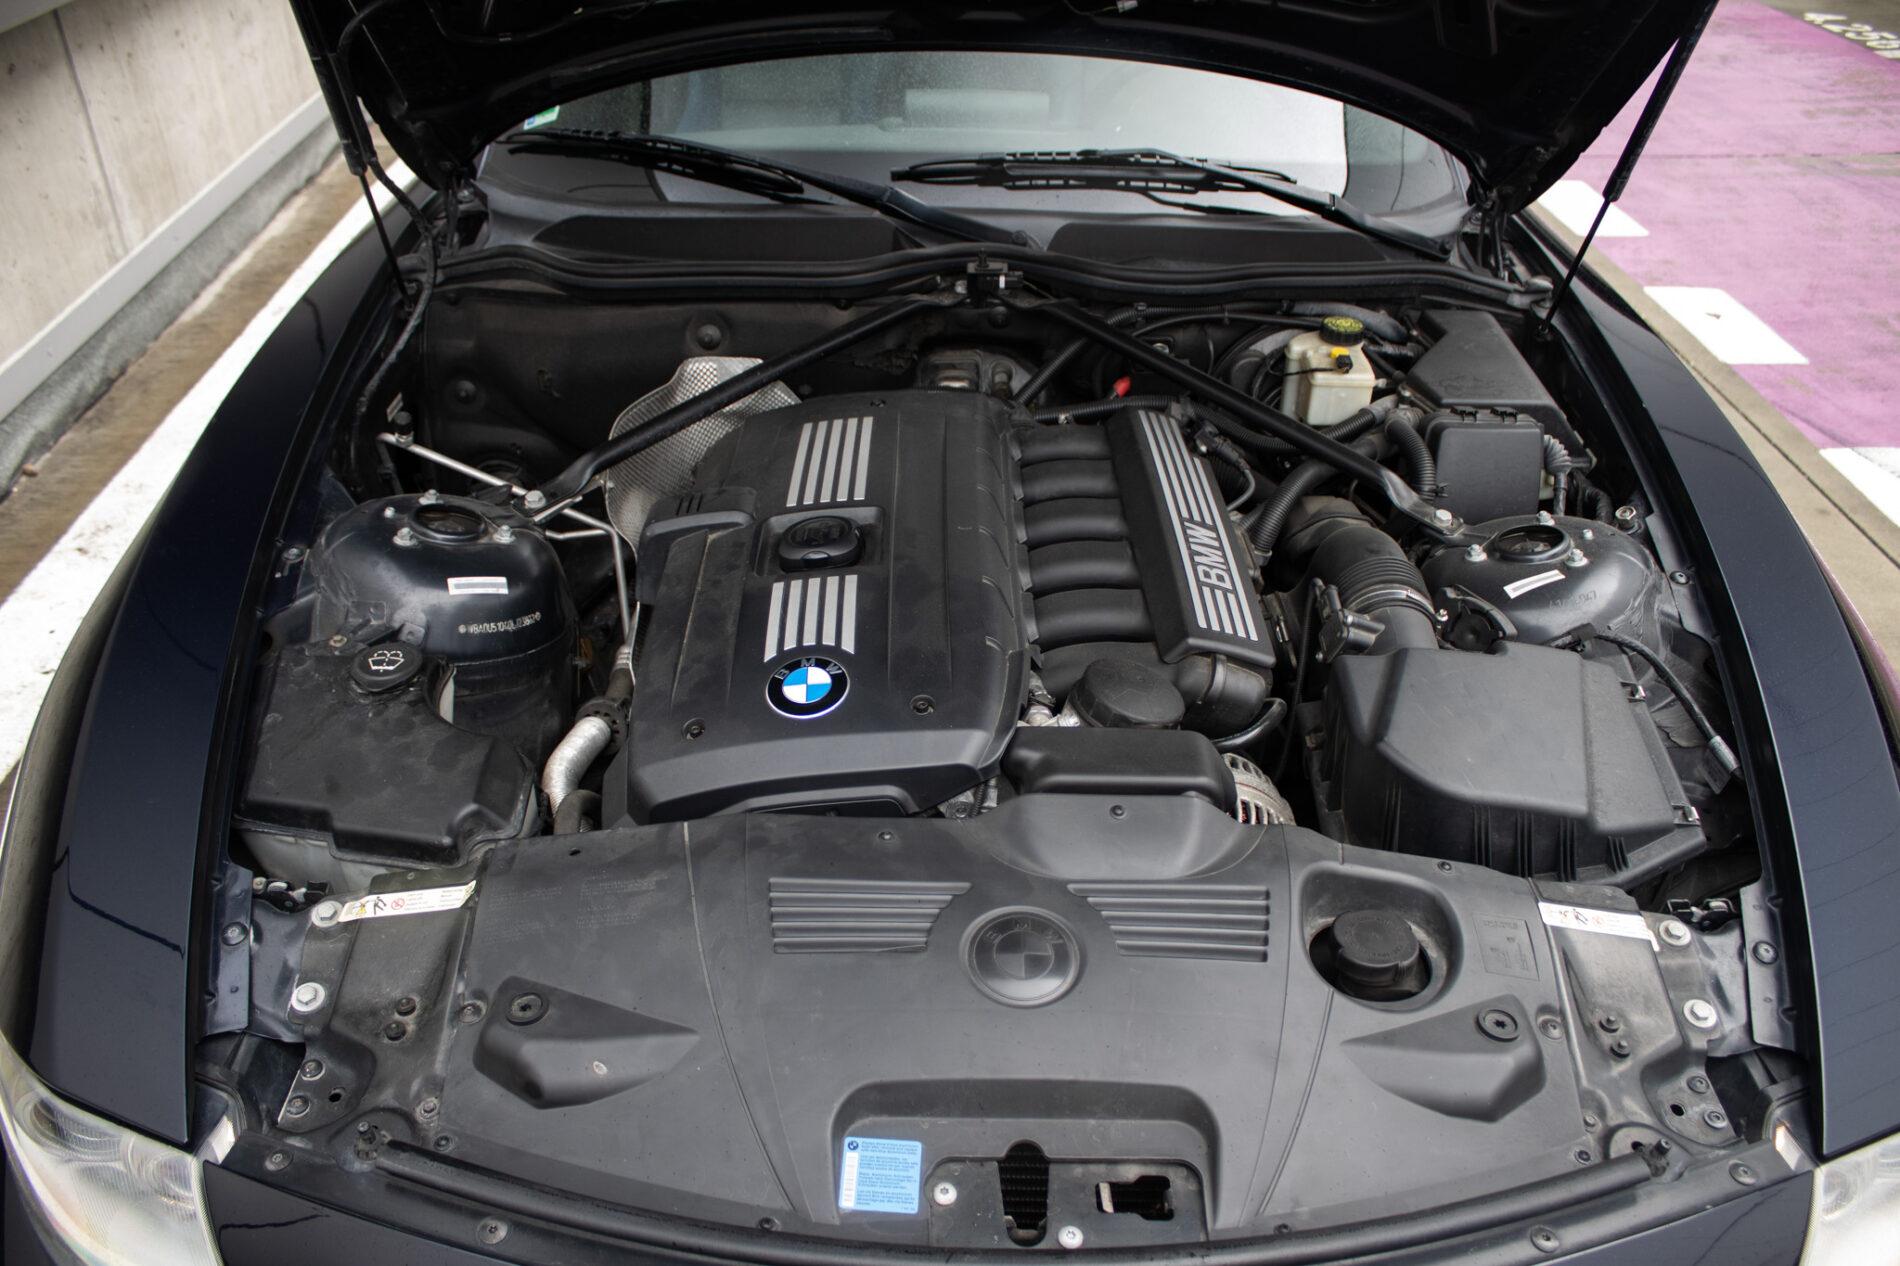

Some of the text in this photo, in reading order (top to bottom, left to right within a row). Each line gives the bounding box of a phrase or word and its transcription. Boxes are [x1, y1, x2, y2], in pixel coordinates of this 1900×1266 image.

[1183, 521, 1233, 590] BMW
[774, 657, 843, 680] BMW
[984, 919, 1064, 945] BMW
